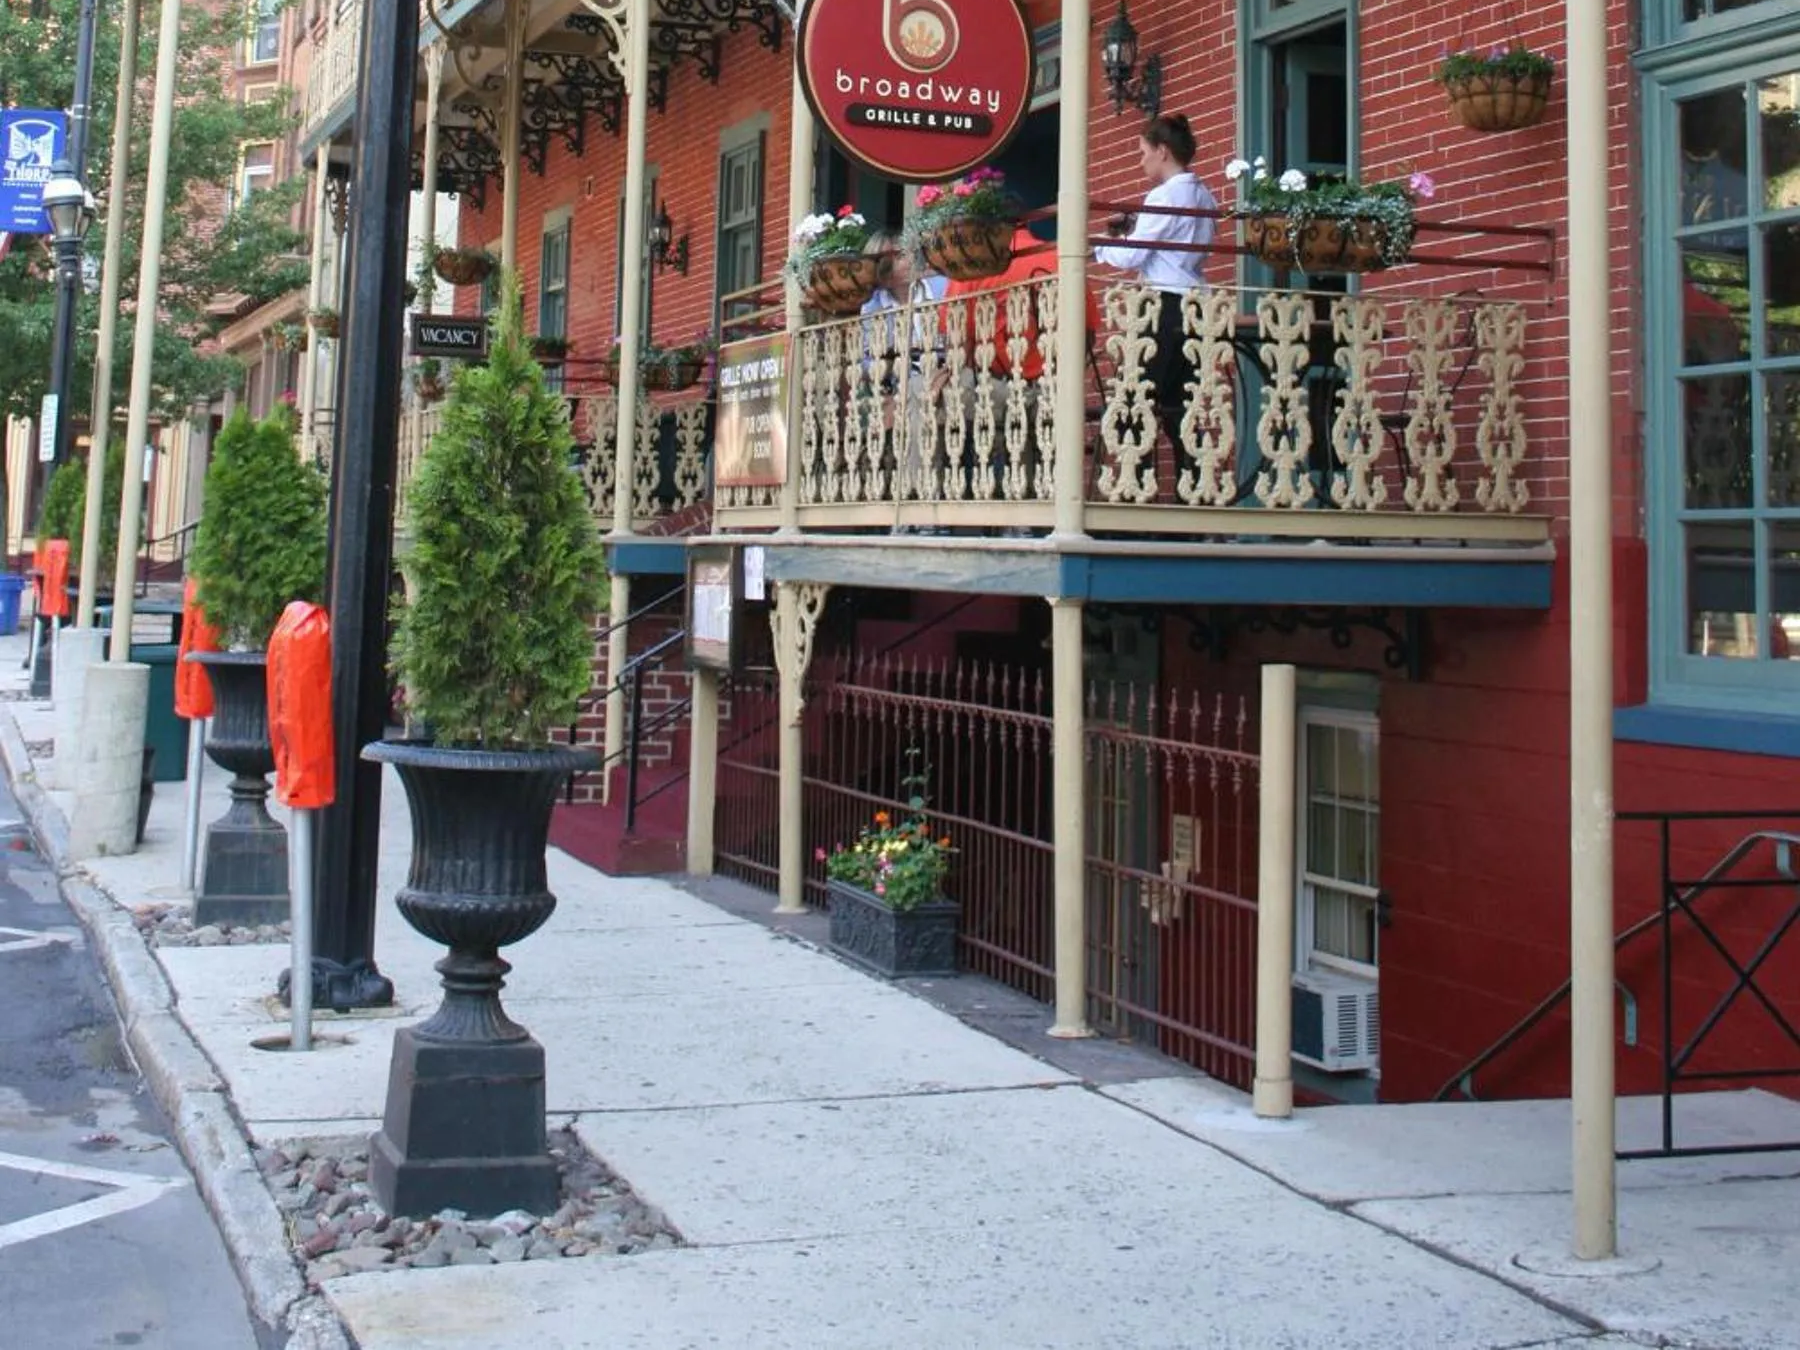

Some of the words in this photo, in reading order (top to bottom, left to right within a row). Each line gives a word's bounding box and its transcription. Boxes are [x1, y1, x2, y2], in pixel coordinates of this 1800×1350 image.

[836, 68, 1000, 113] broadway
[865, 109, 920, 125] GRILLE
[928, 114, 937, 126] &
[944, 116, 973, 129] PUB
[421, 327, 478, 345] VACANCY
